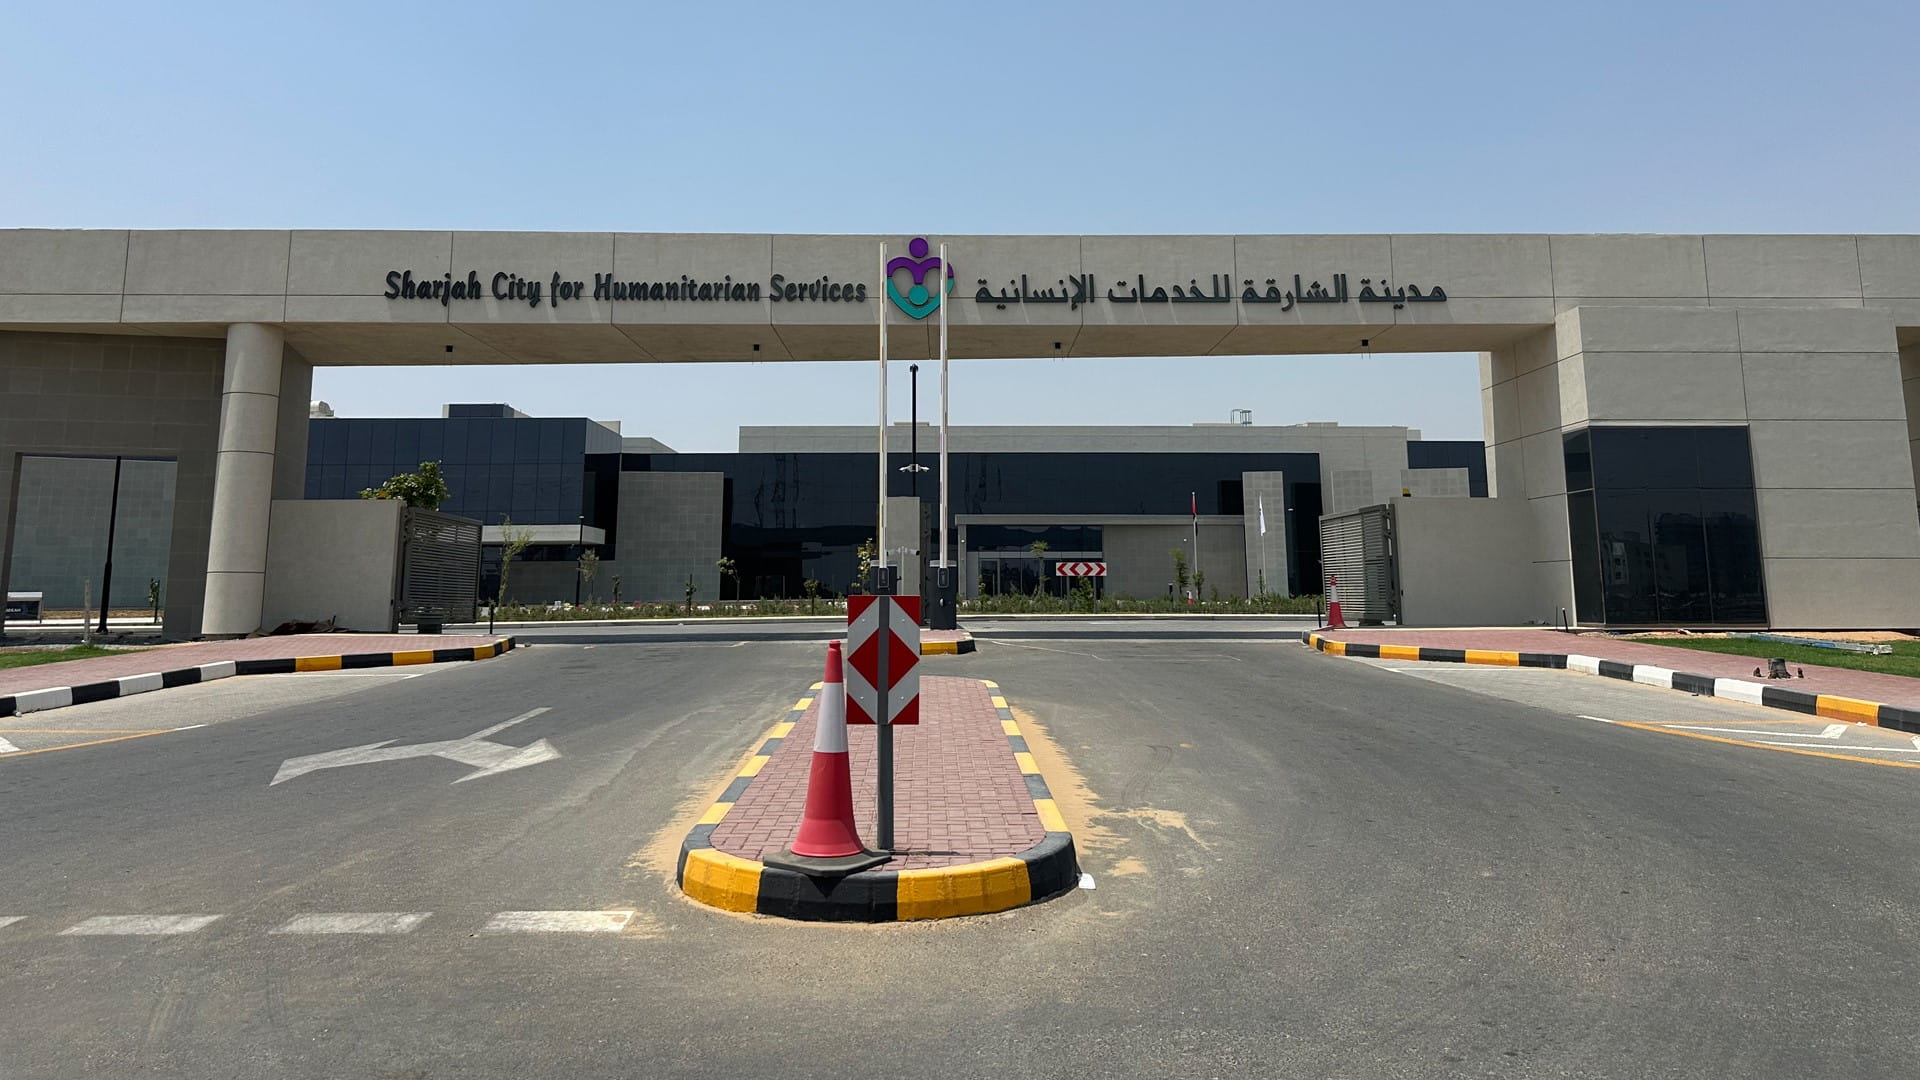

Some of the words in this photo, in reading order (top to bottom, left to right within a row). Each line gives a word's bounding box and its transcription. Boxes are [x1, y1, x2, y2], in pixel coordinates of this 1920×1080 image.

[384, 270, 482, 307] Sharjah
[491, 272, 541, 308] City
[551, 272, 584, 308] for
[594, 273, 762, 302] Humanitarian
[769, 274, 868, 303] Services
[975, 274, 1095, 311] الإنسانية
[1107, 274, 1231, 304] للخدمات
[1242, 273, 1348, 312] الشارقة
[1358, 279, 1447, 310] مدينة
